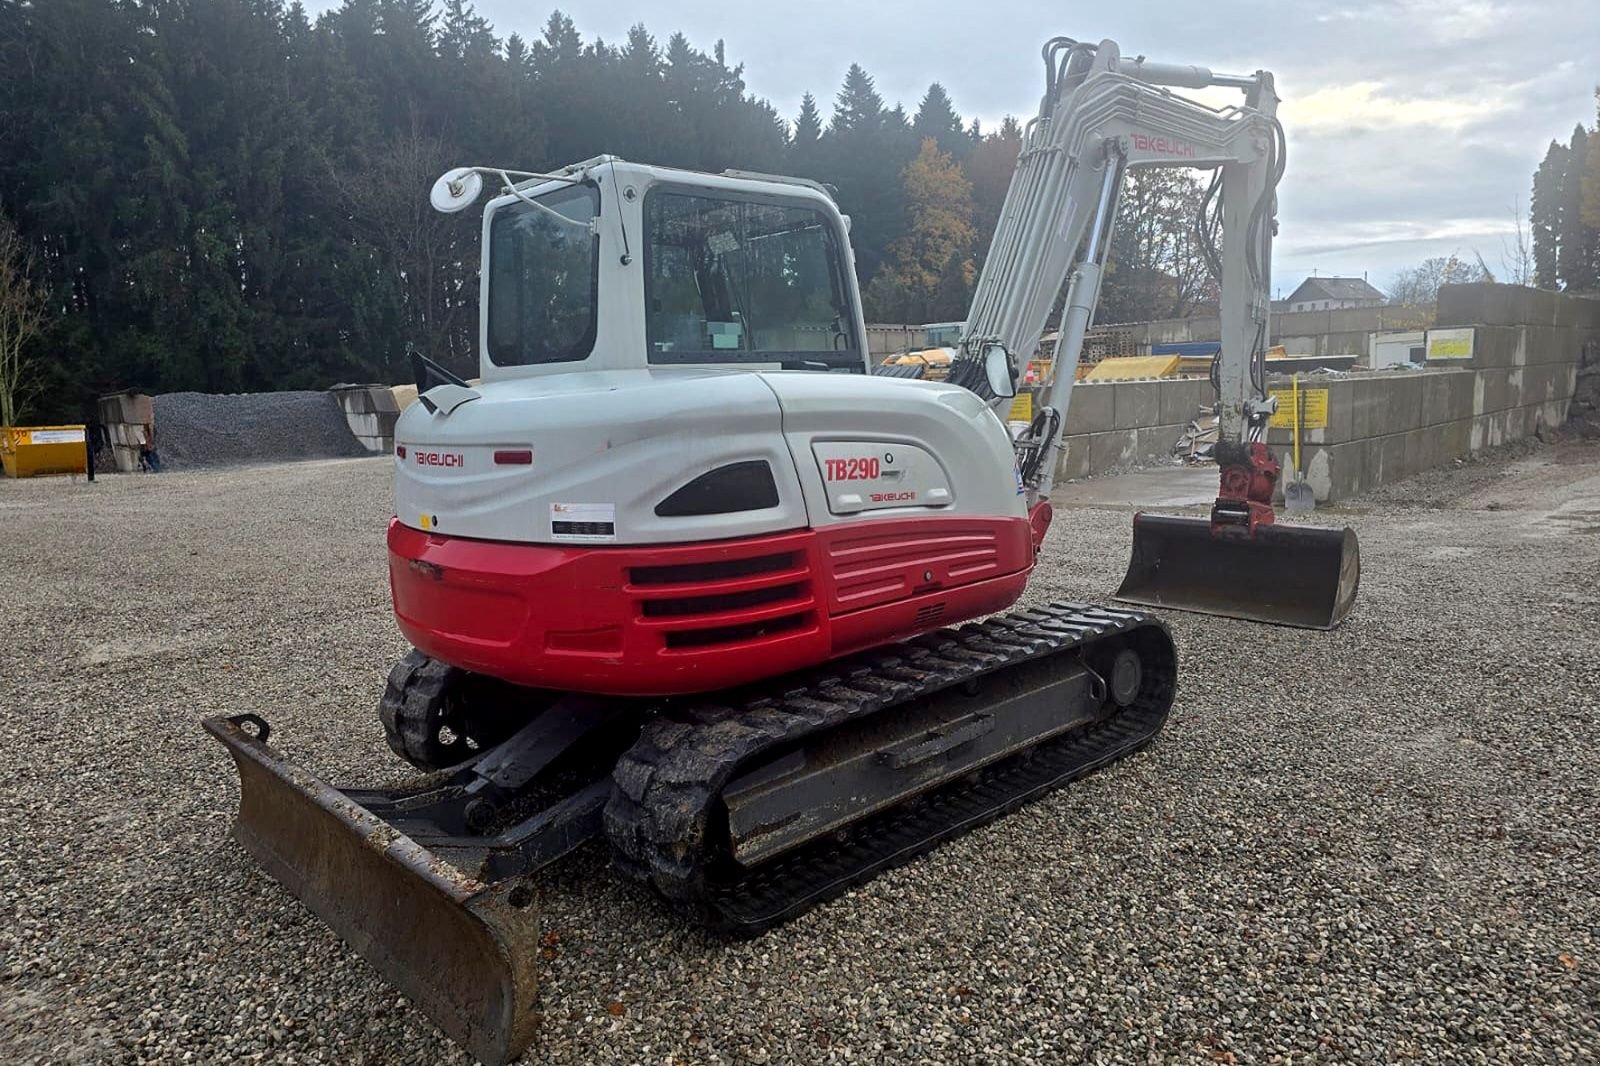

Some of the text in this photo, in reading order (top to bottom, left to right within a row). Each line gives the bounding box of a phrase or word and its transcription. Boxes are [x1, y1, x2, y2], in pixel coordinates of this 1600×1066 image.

[1130, 134, 1195, 156] TAKEUCHI
[415, 452, 464, 467] TAKEUCHI
[825, 458, 879, 481] TB290
[869, 491, 915, 502] TAKEUCHI
